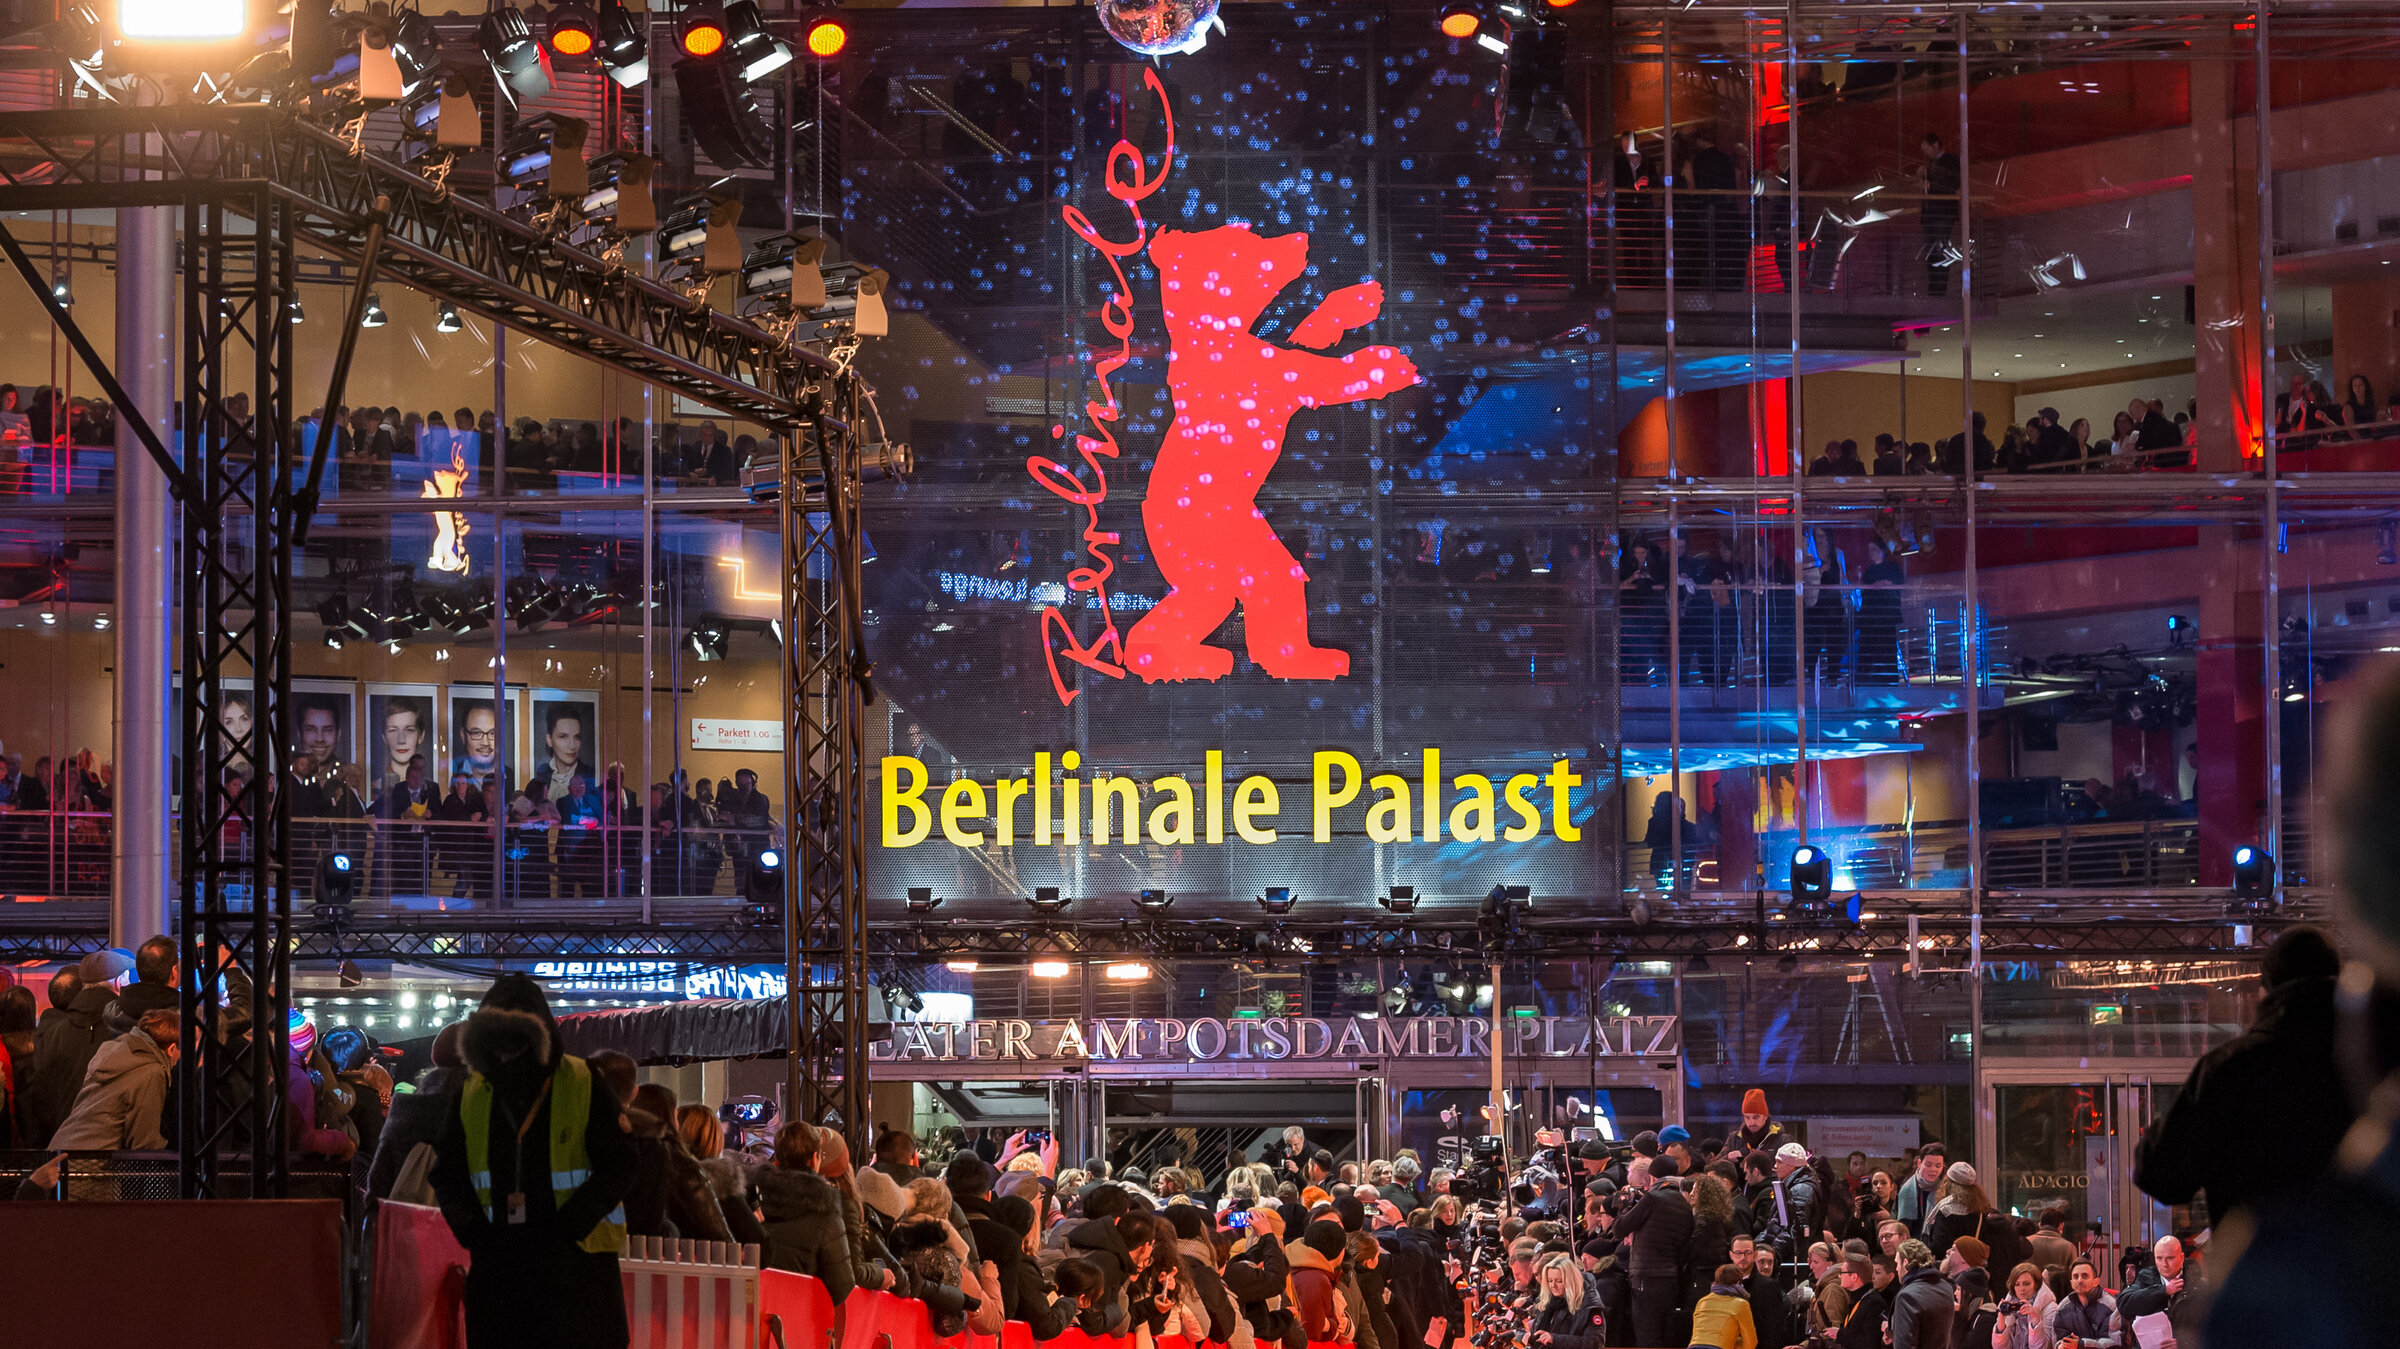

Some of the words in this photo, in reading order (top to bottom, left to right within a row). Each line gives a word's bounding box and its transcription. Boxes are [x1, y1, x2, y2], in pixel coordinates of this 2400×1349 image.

[1027, 67, 1174, 707] Berlinale
[718, 727, 751, 738] Parkett
[881, 749, 1281, 848] Berlinale
[1312, 747, 1583, 843] Palast
[815, 1018, 1040, 1062] EATER
[1050, 1018, 1143, 1061] AM
[1155, 1016, 1491, 1060] POTSDAMER
[1508, 1015, 1679, 1057] PLATZ
[2018, 1175, 2091, 1189] ADAGIO
